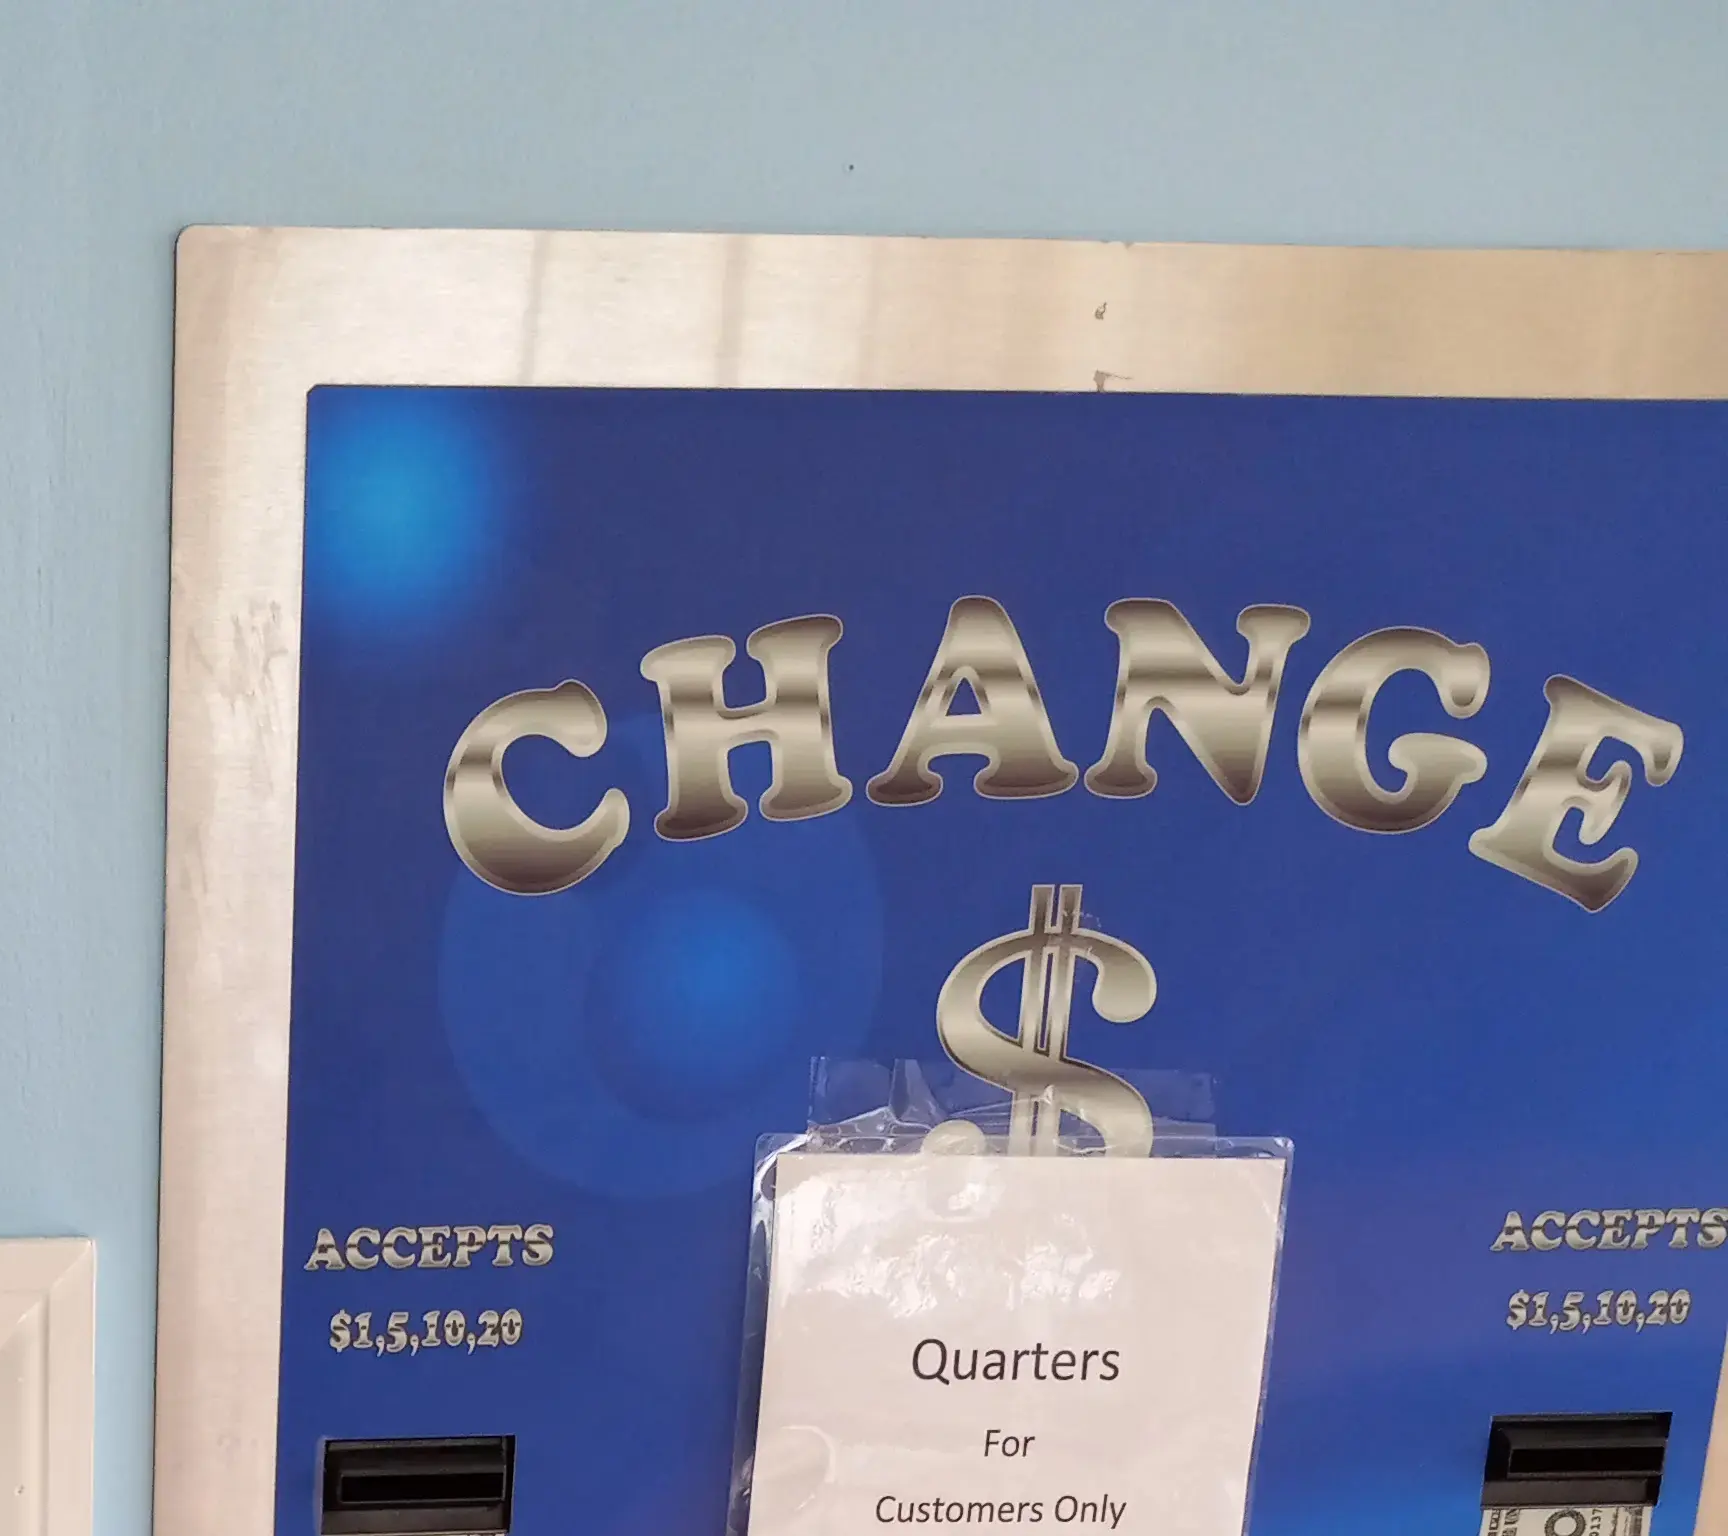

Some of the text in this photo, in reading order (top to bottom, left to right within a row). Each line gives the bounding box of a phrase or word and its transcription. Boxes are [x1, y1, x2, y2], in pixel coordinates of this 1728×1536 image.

[443, 596, 1684, 913] CHANGE
[304, 1224, 554, 1271] ACCEPTS
[1490, 1208, 1728, 1252] ACCEPTS
[330, 1308, 523, 1357] $1,5,10,20
[1506, 1289, 1691, 1335] $1,5,10,20
[912, 1337, 1121, 1384] Quarters
[984, 1427, 1036, 1458] For
[875, 1493, 1127, 1530] Customers Only
